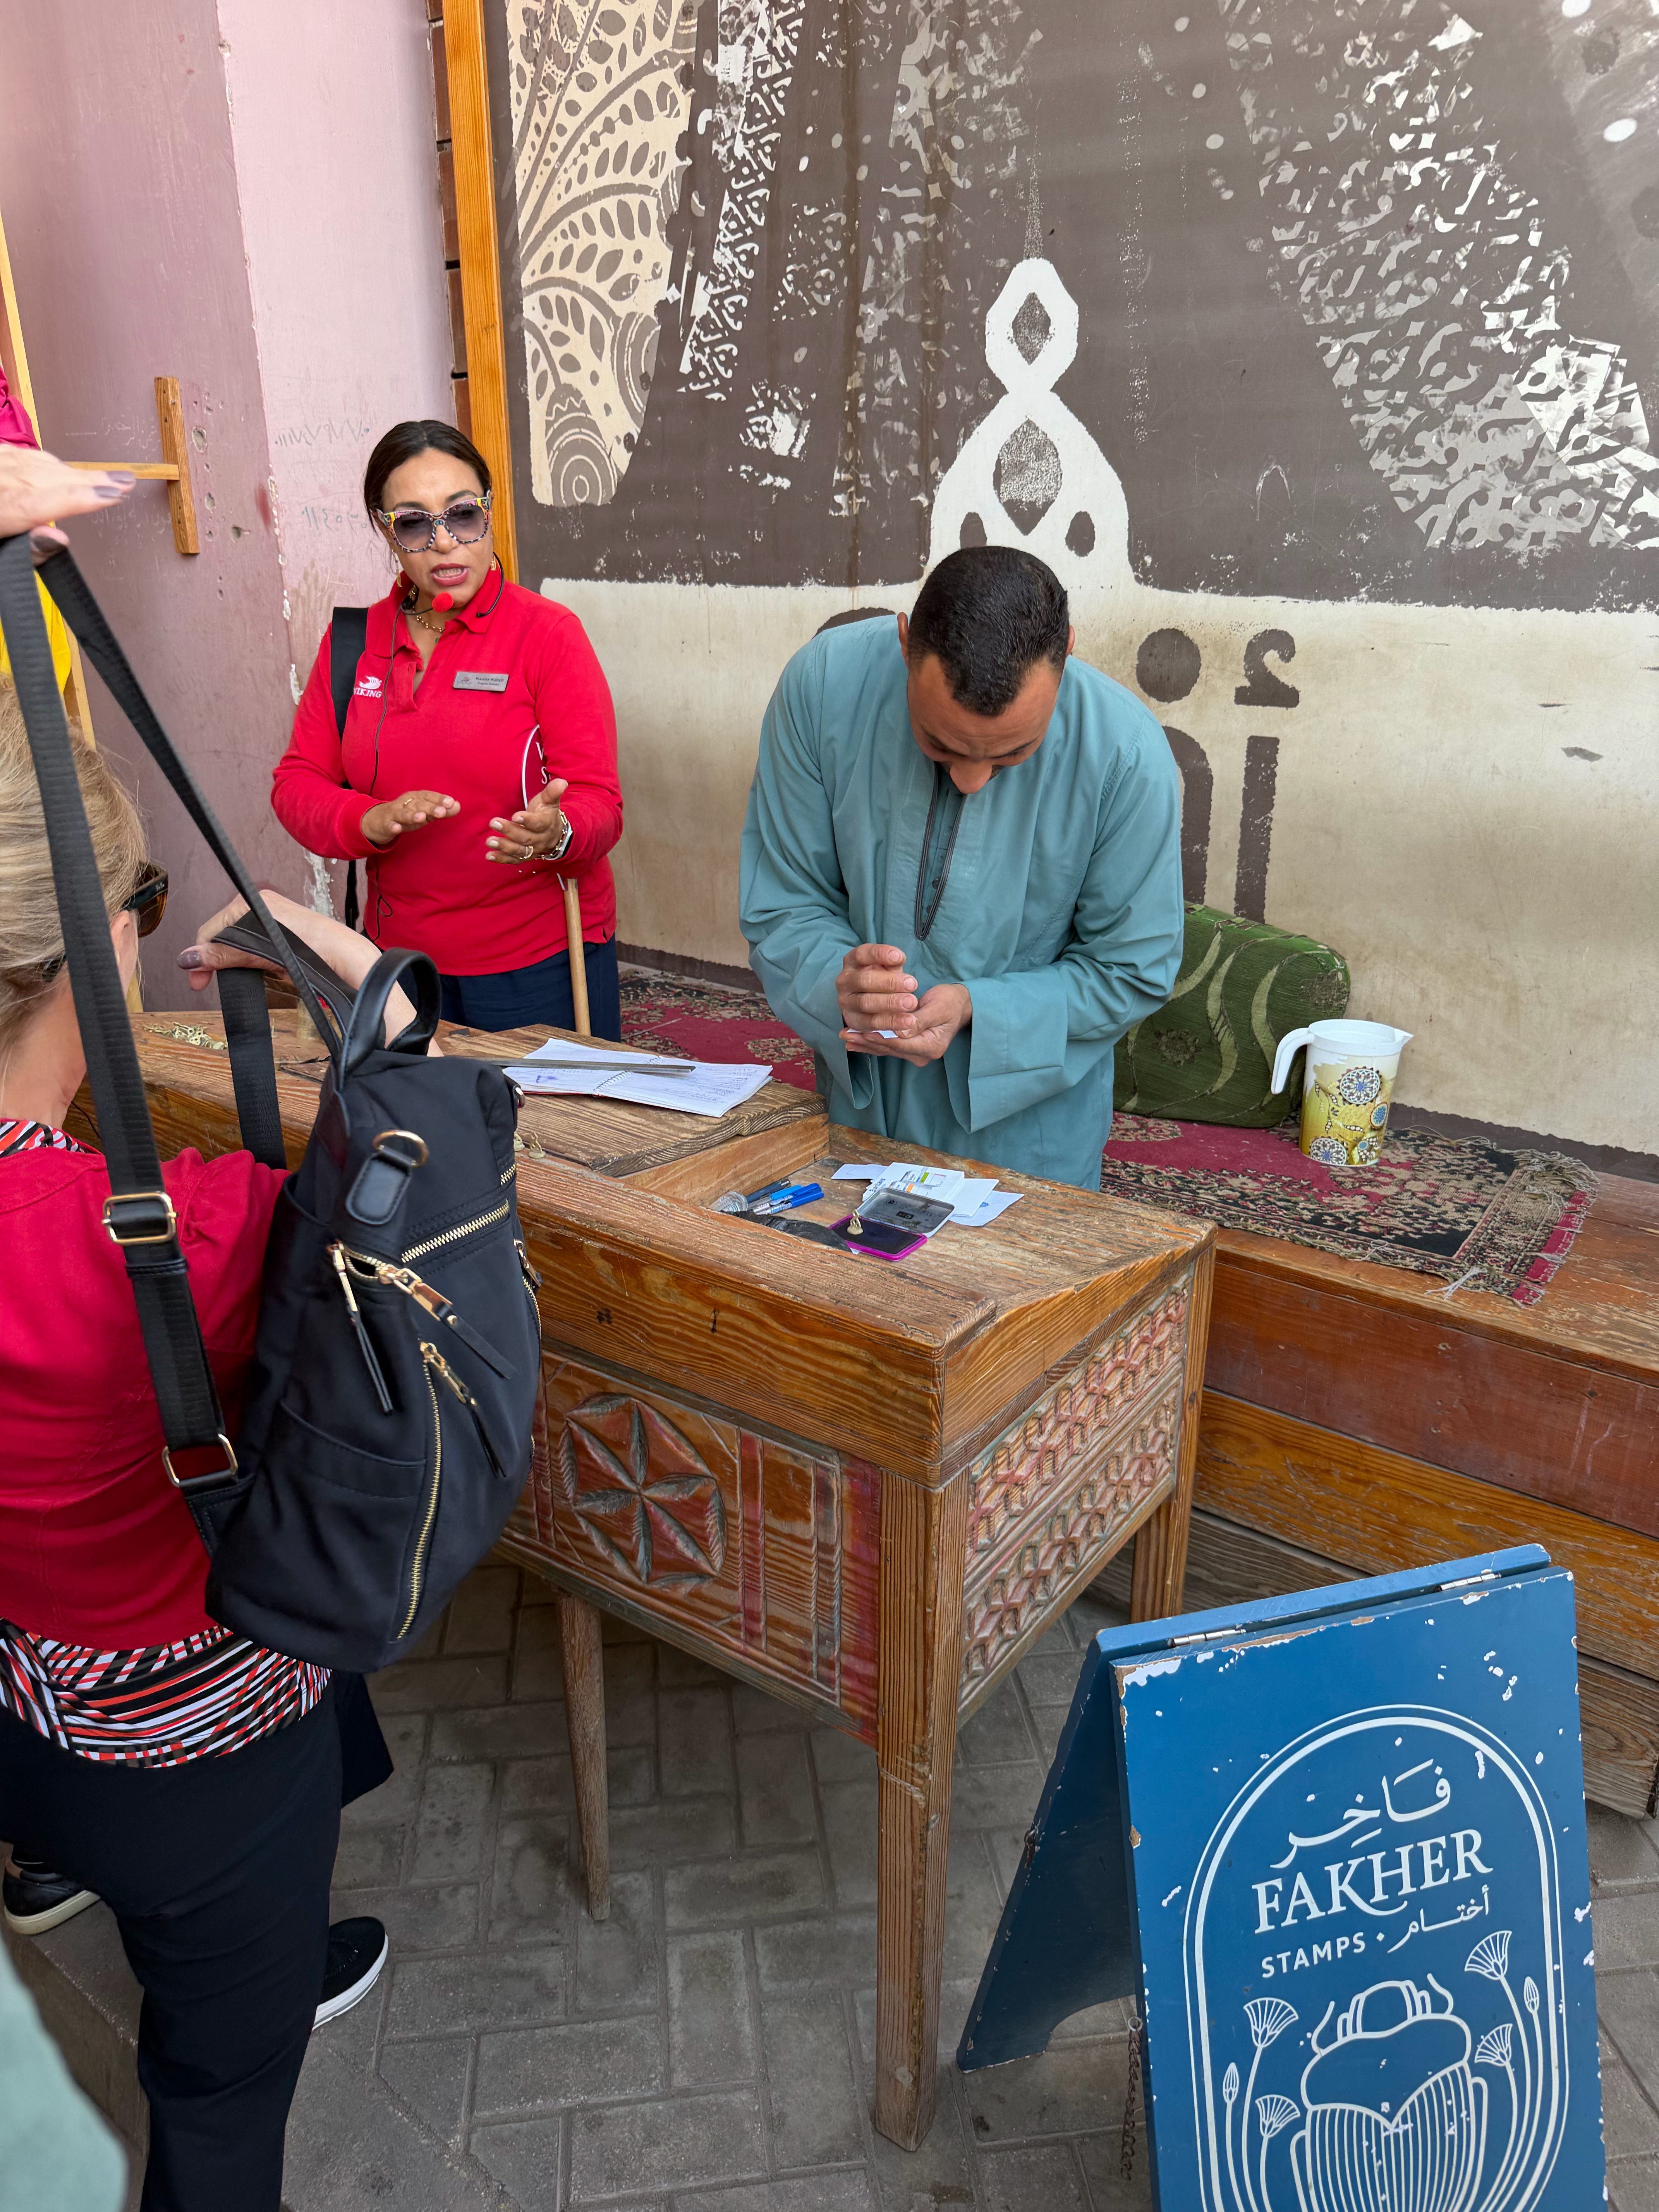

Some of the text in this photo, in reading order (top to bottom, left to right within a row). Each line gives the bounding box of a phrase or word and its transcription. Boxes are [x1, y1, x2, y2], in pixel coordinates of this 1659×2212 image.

[1252, 1829, 1493, 1934] FAKHER
[1261, 1884, 1489, 1978] STAMPS أختام
